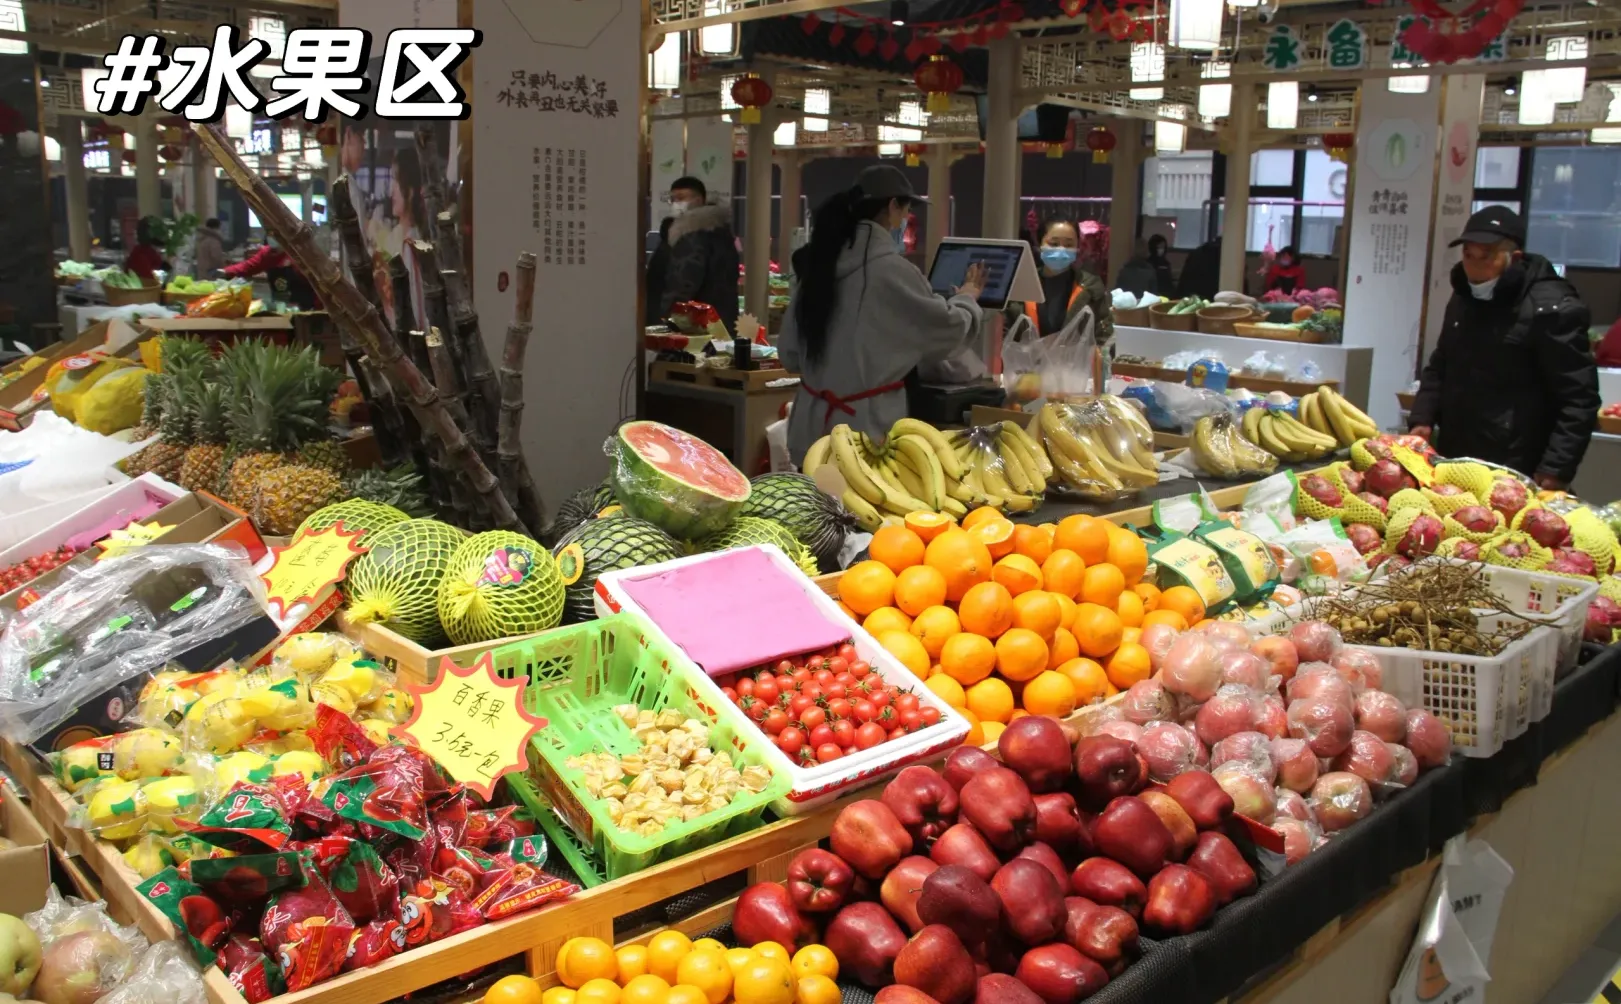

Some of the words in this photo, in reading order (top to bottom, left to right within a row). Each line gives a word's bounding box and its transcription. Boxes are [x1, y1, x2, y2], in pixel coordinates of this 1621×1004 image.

[510, 69, 608, 100] 只要内心美好
[496, 88, 620, 119] 外表再丑也无关紧要
[452, 682, 505, 729] 百香果
